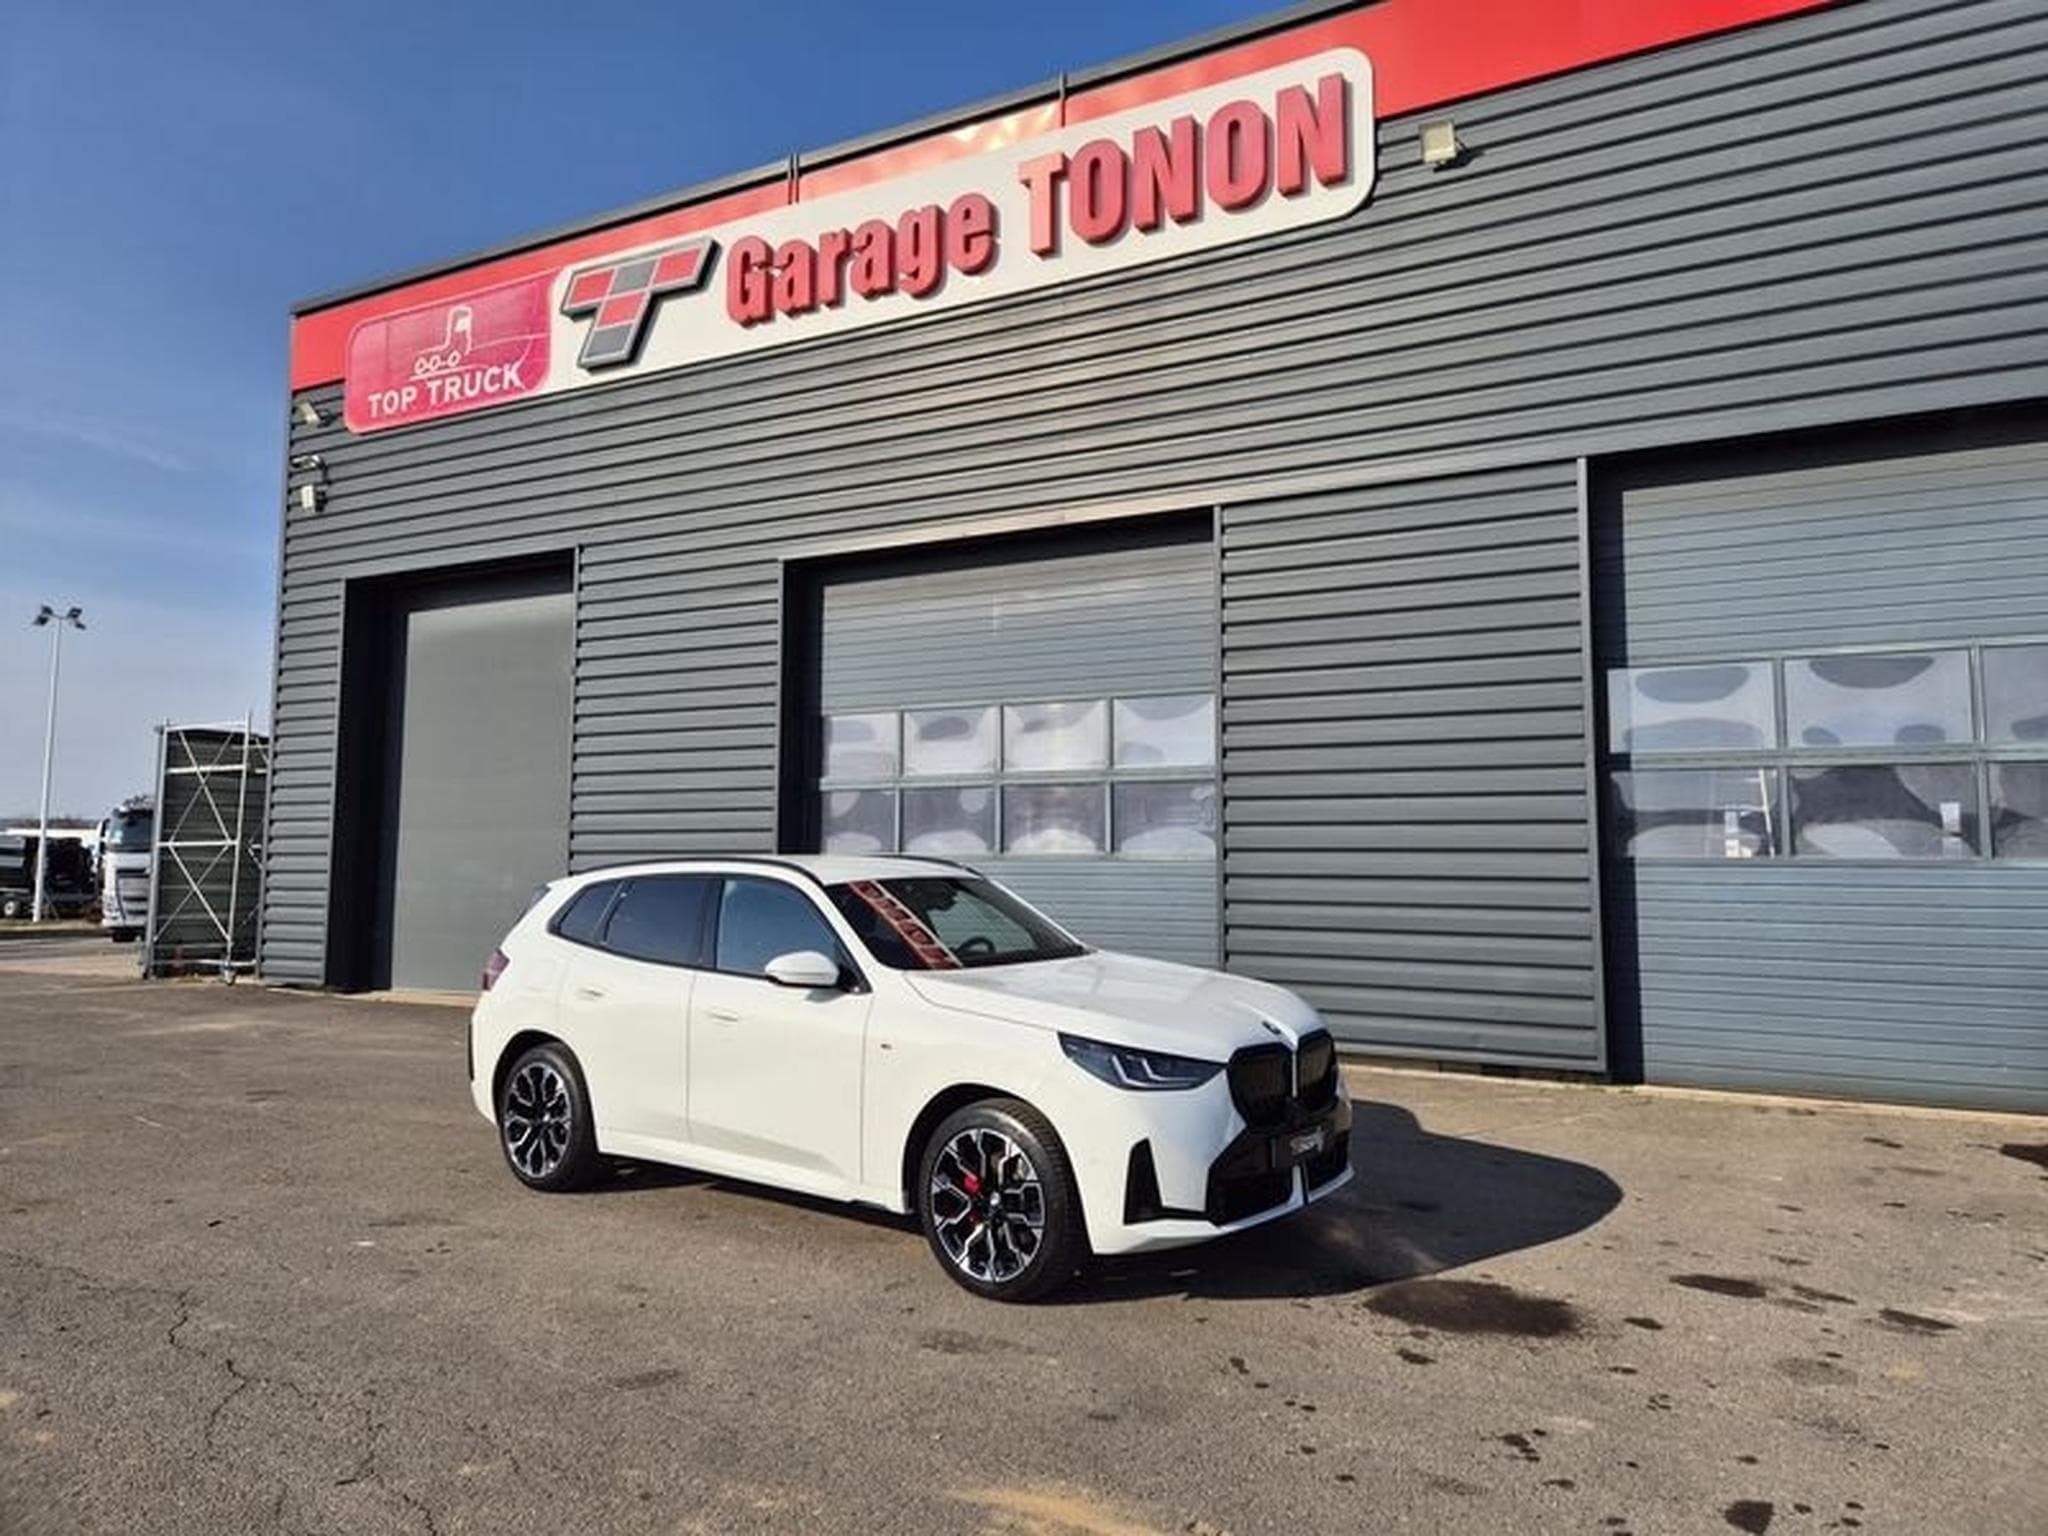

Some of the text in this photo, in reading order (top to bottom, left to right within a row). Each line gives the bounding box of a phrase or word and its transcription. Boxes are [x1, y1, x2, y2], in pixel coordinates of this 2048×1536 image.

[726, 73, 1351, 326] Garage TONON
[367, 363, 523, 418] TOP TRUCK
